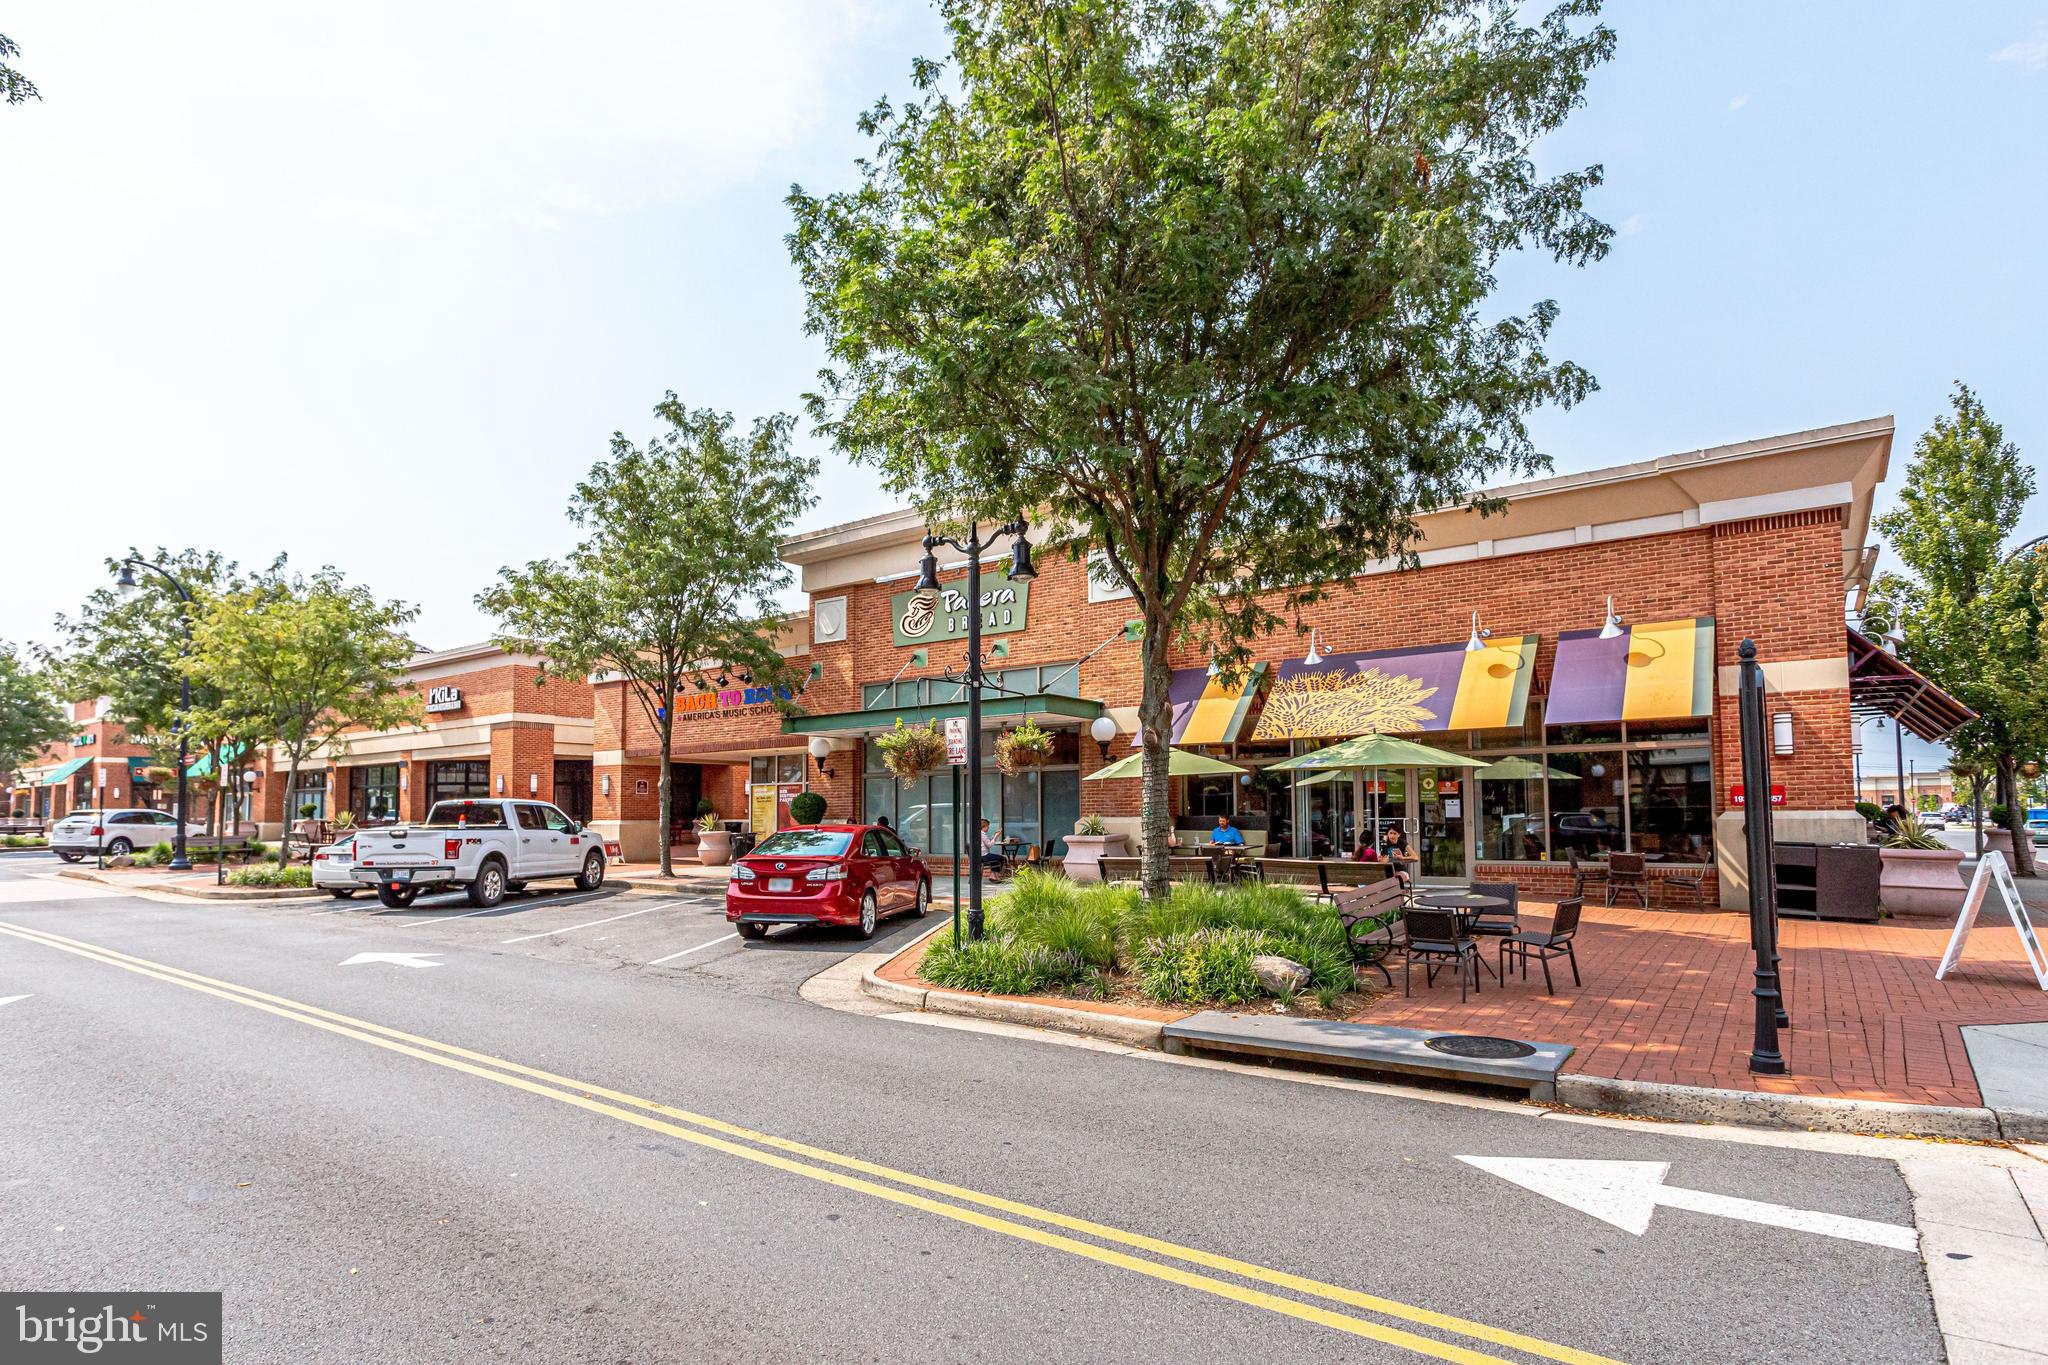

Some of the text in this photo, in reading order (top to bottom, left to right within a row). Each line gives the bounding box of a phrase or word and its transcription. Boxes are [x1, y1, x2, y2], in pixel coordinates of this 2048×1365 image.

[941, 588, 1015, 613] Paera
[948, 608, 1012, 632] BRAD
[675, 693, 718, 713] BACH
[720, 691, 741, 708] TO
[683, 705, 779, 722] AMERICA'S MUSIC SCHOO
